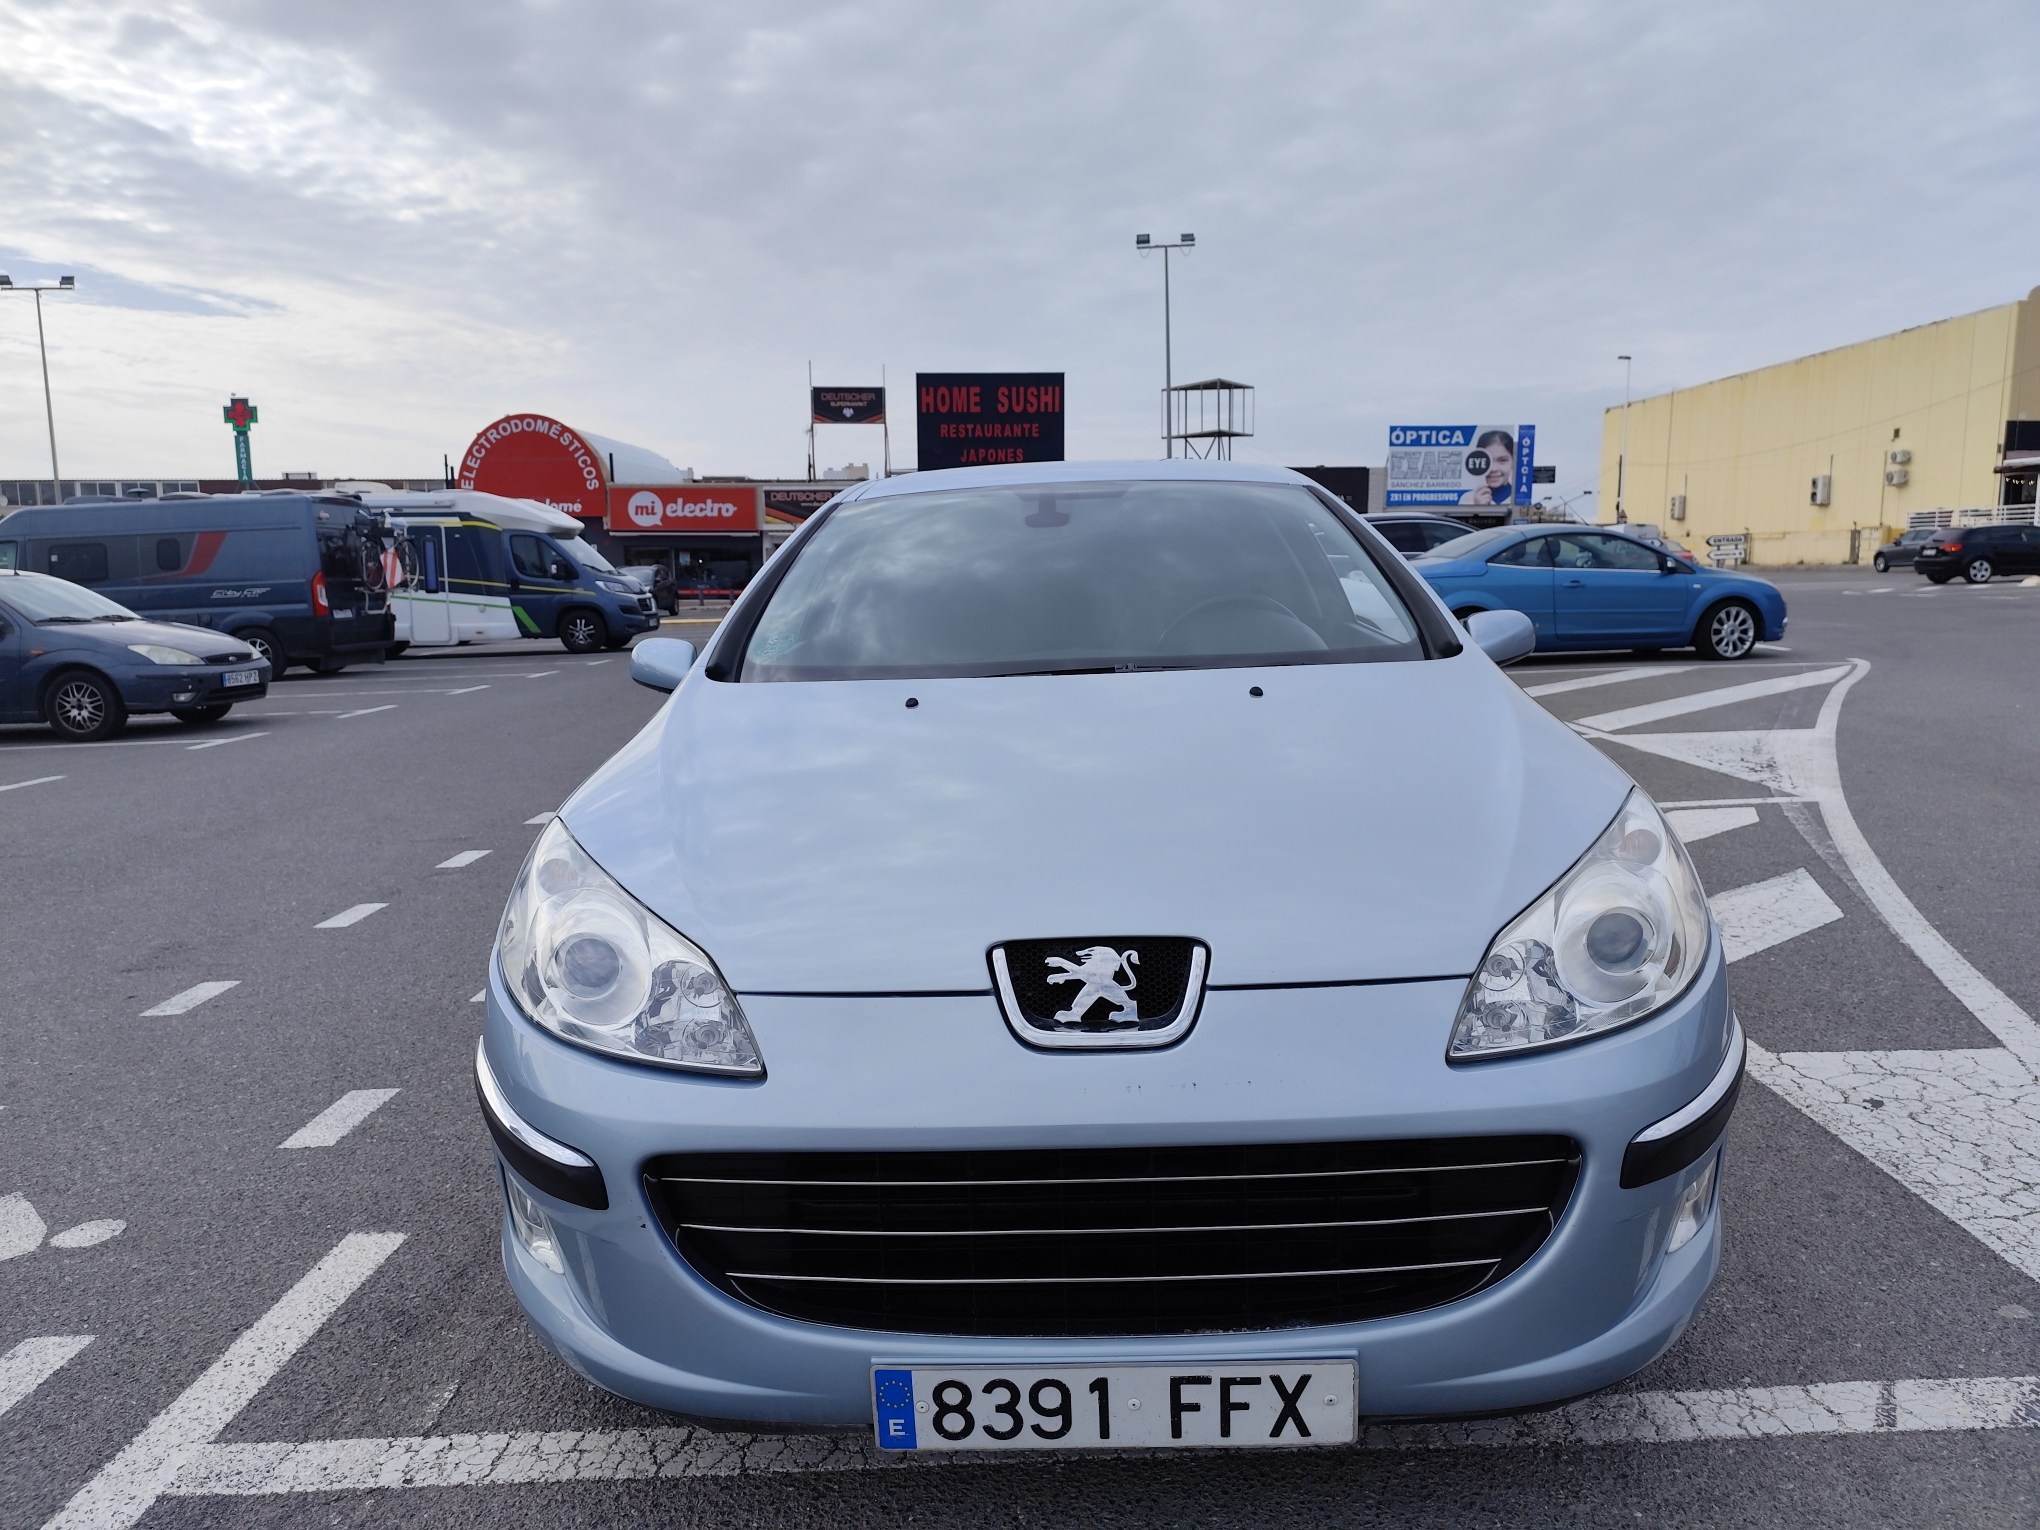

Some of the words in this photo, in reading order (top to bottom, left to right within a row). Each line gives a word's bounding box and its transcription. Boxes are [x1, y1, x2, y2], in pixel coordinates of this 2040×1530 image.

[821, 392, 876, 401] DEUTSCHER
[921, 386, 981, 413] HOME
[997, 386, 1060, 413] SUSHI
[940, 423, 1040, 438] RESTAURANTE
[1391, 428, 1465, 445] ÓPTICA
[239, 435, 249, 480] FARMACIA
[461, 418, 599, 490] ELECTRODOMÉSTICOS
[961, 448, 1024, 462] JAPONES
[1468, 457, 1487, 469] EYE
[770, 491, 832, 501] DEUTSCHER
[634, 500, 657, 516] mi
[666, 497, 737, 518] electro
[888, 1418, 906, 1436] E
[931, 1376, 1111, 1441] 8391
[1169, 1373, 1312, 1439] FFX
